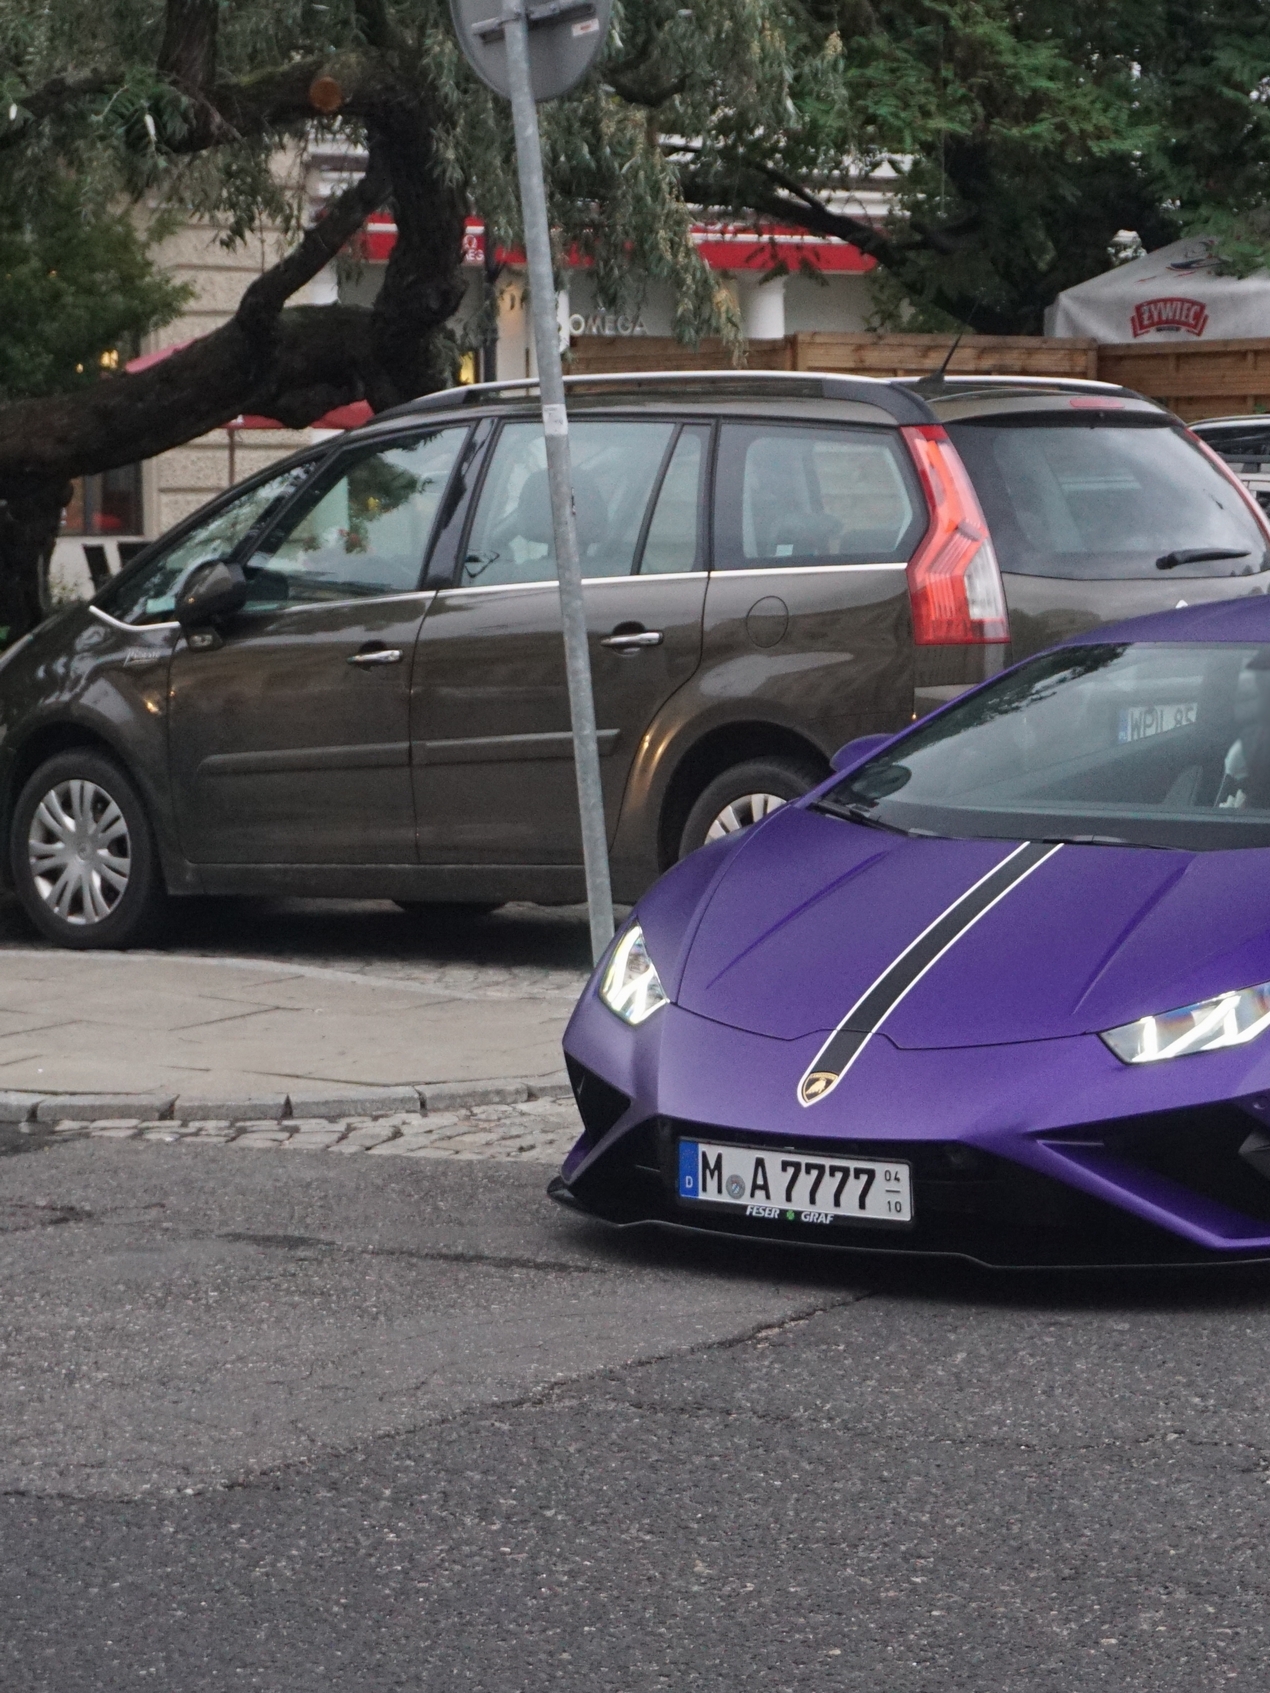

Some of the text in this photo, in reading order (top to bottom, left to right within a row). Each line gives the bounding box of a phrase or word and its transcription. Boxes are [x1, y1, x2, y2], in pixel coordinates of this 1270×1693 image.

[569, 313, 648, 336] OMEGA
[685, 1150, 876, 1210] D M A 7777
[884, 1169, 901, 1182] 04
[746, 1205, 835, 1224] FESER GRAF
[887, 1201, 902, 1213] 10
